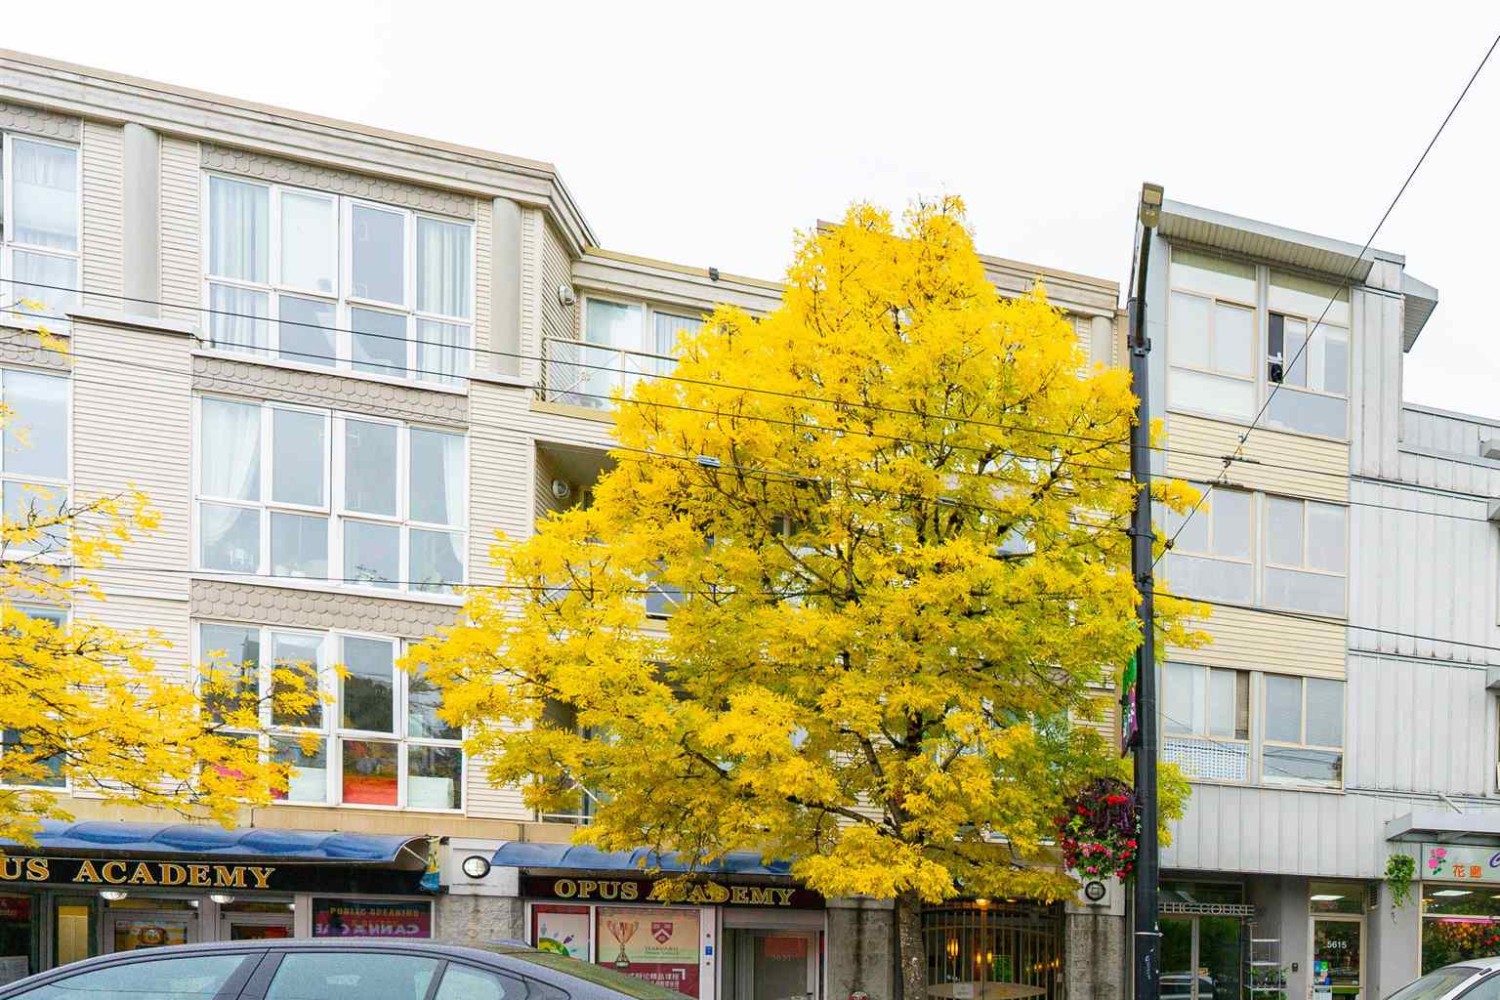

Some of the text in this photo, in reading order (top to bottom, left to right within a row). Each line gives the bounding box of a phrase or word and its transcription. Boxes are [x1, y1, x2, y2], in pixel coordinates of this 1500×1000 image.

[72, 859, 276, 889] ACADEMY
[553, 878, 796, 906] OPUS ADEMY
[1327, 940, 1348, 949] 5615
